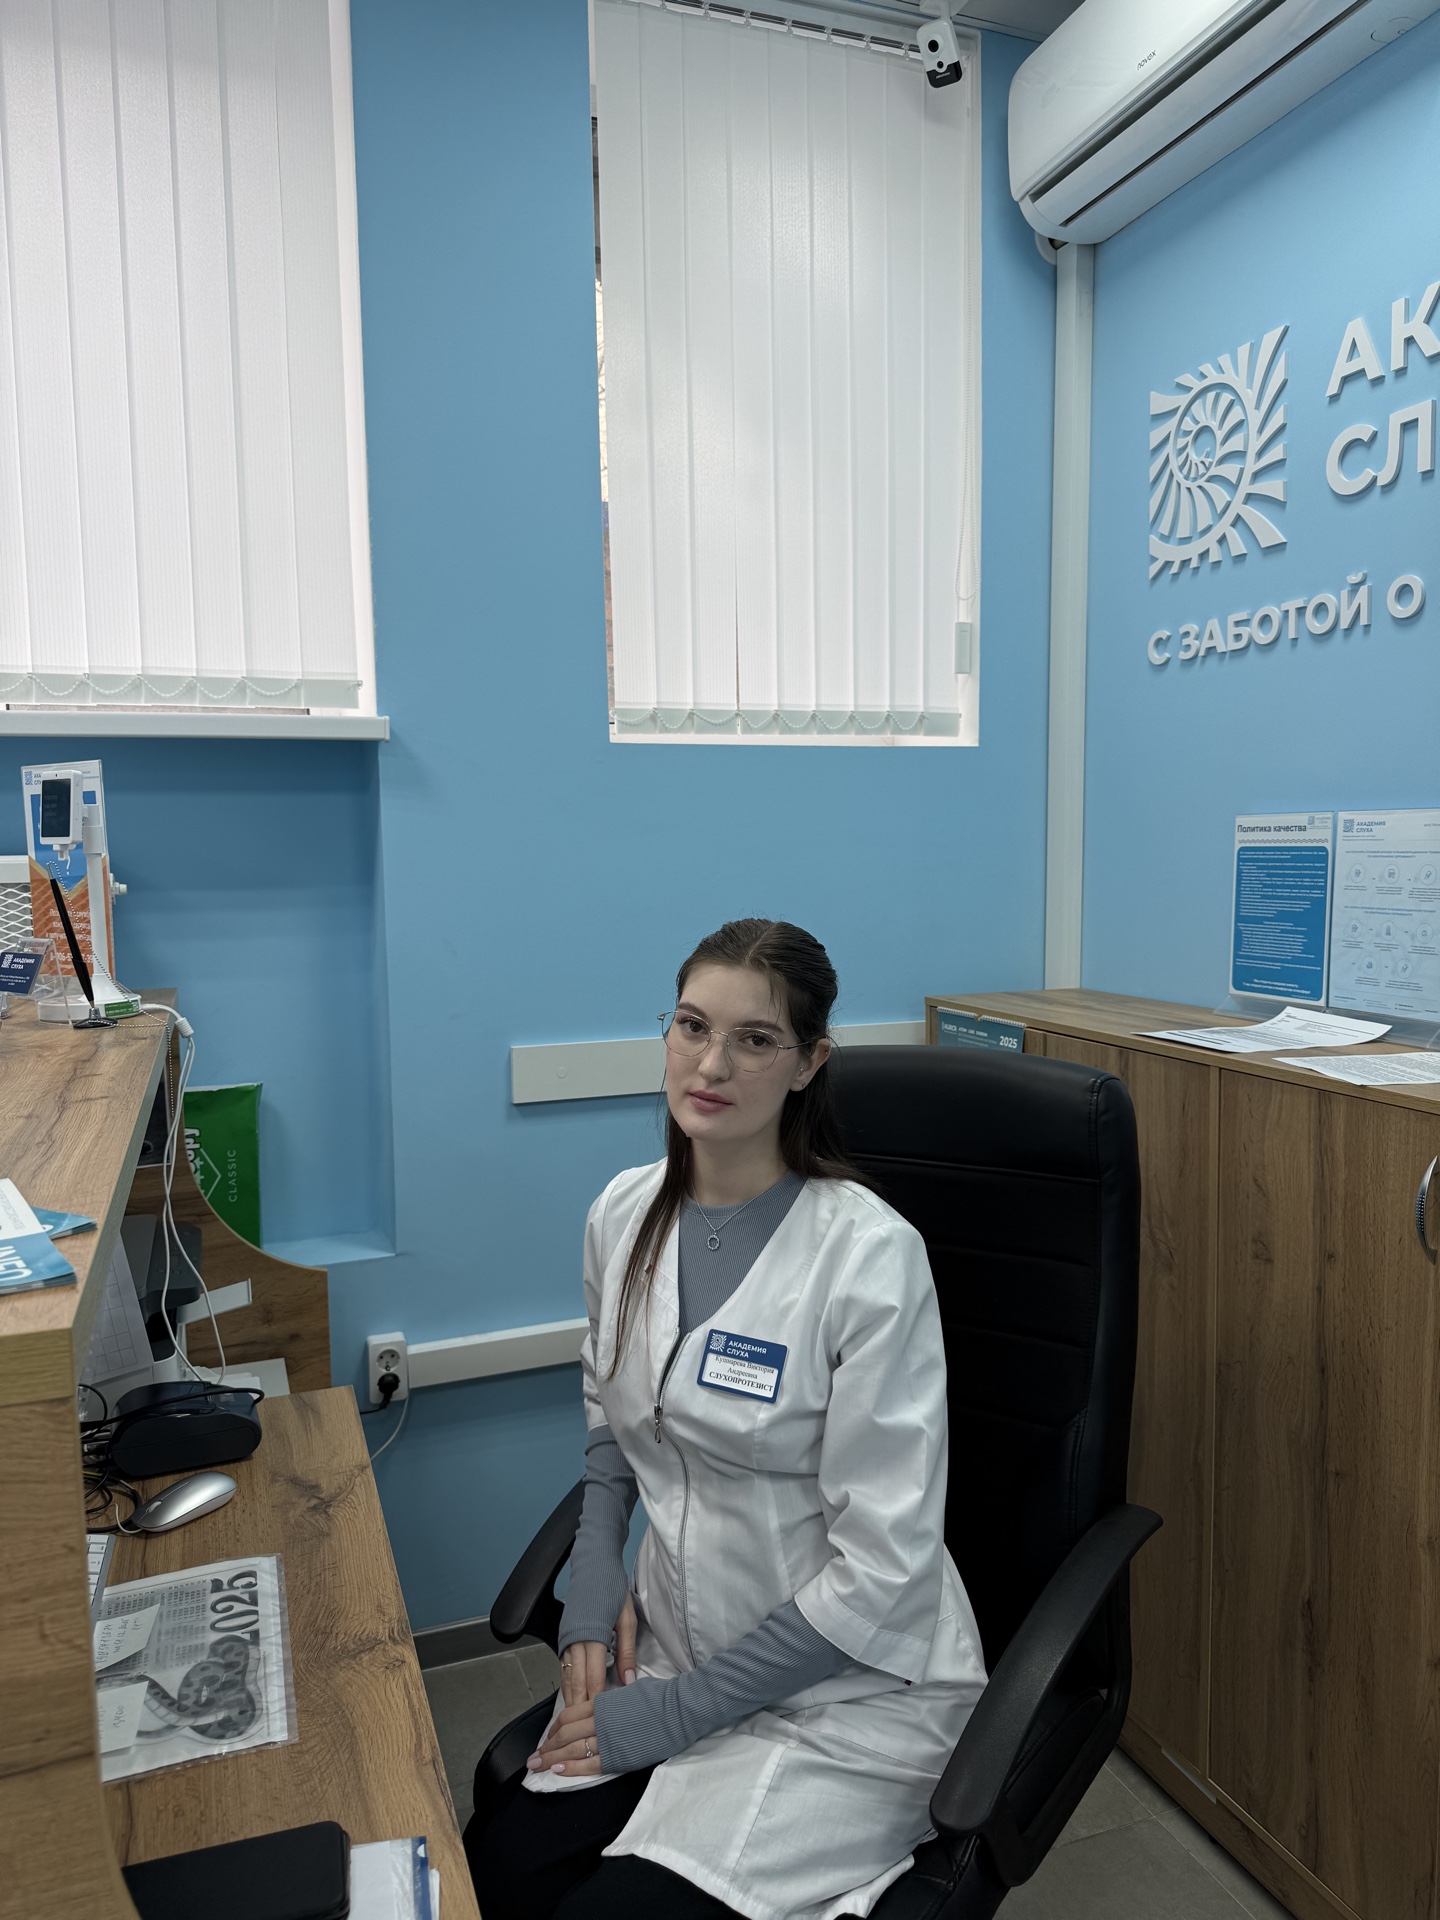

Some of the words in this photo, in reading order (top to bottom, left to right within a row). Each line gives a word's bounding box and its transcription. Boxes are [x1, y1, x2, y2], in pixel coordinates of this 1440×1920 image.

[1136, 49, 1156, 71] novex
[1147, 630, 1172, 666] С
[1178, 571, 1372, 661] ЗАБОТОЙ
[1386, 574, 1426, 620] О
[1237, 824, 1272, 833] Политика
[1273, 824, 1307, 832] качества
[999, 1035, 1018, 1049] 2025
[227, 1149, 238, 1202] CLASSIC
[726, 1348, 749, 1358] СЛУХА
[728, 1340, 767, 1354] АКАДЕМИЯ
[727, 1367, 758, 1379] Андреевна
[747, 1362, 775, 1374] Виктория
[709, 1371, 773, 1392] СЛУХОПРОТЕЗИСТ
